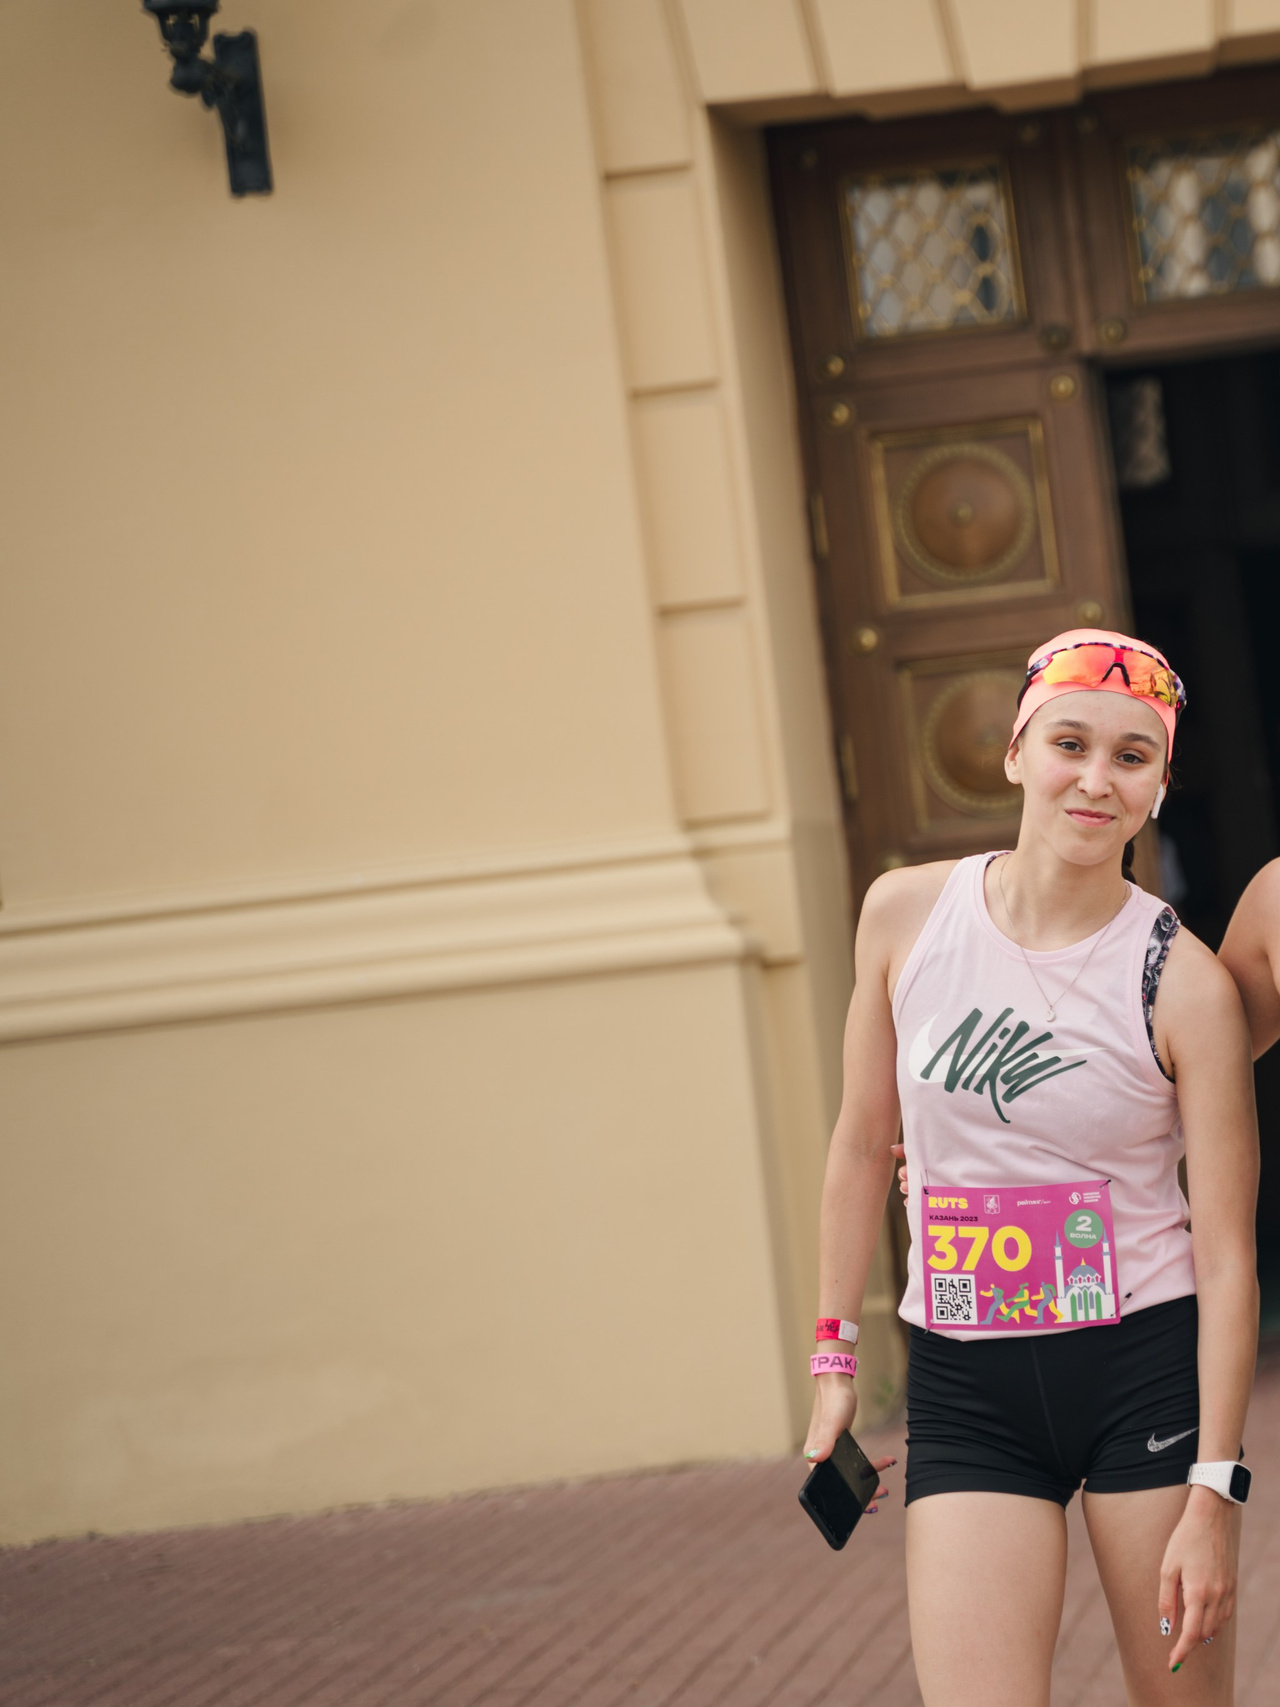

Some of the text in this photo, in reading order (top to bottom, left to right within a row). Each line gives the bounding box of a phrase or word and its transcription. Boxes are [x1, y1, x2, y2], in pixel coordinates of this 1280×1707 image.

[928, 1196, 969, 1209] RUTS
[929, 1214, 959, 1222] КАЗАНЬ
[1075, 1215, 1092, 1232] 2
[1069, 1232, 1097, 1240] ВОЛНА
[927, 1225, 1032, 1272] 370
